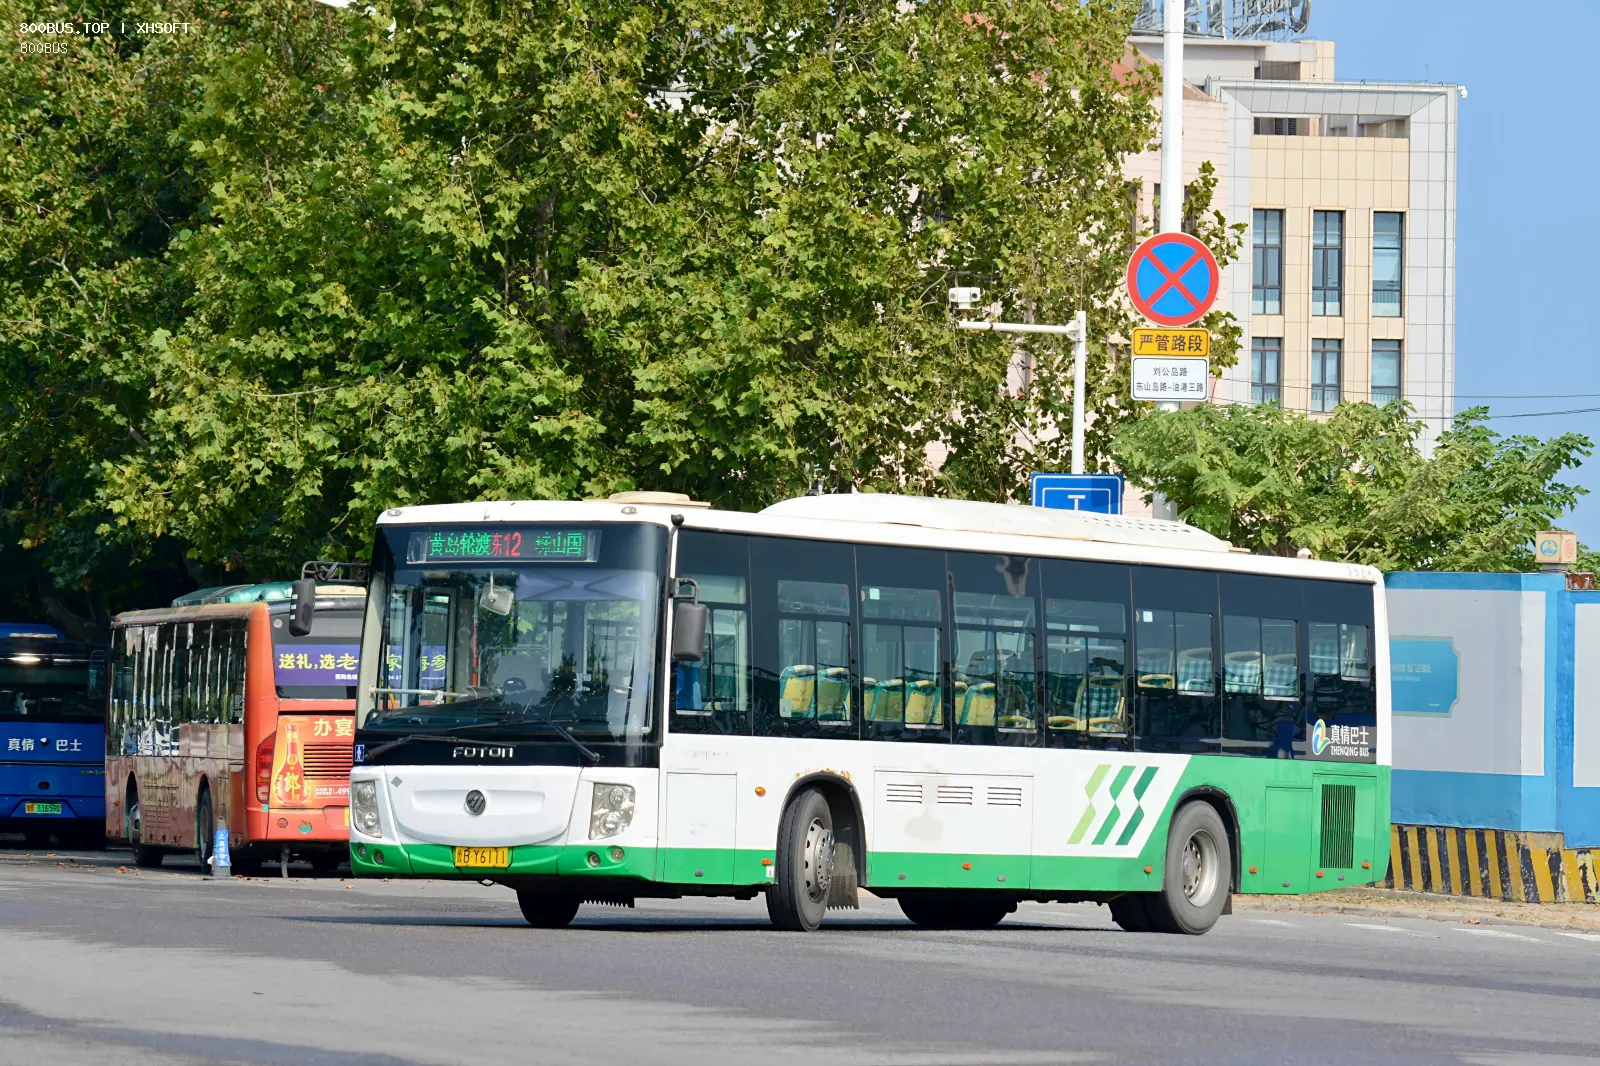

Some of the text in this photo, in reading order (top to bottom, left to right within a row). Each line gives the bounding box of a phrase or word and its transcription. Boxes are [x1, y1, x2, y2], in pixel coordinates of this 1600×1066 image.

[1138, 334, 1203, 352] 严管路段
[1153, 366, 1188, 377] 刘公岛路
[313, 717, 353, 737] 办宴
[1330, 724, 1370, 746] 真情巴士
[7, 738, 83, 752] 真情 巴士
[452, 746, 514, 758] FOTON
[1330, 745, 1370, 757] ZHENQING BUS
